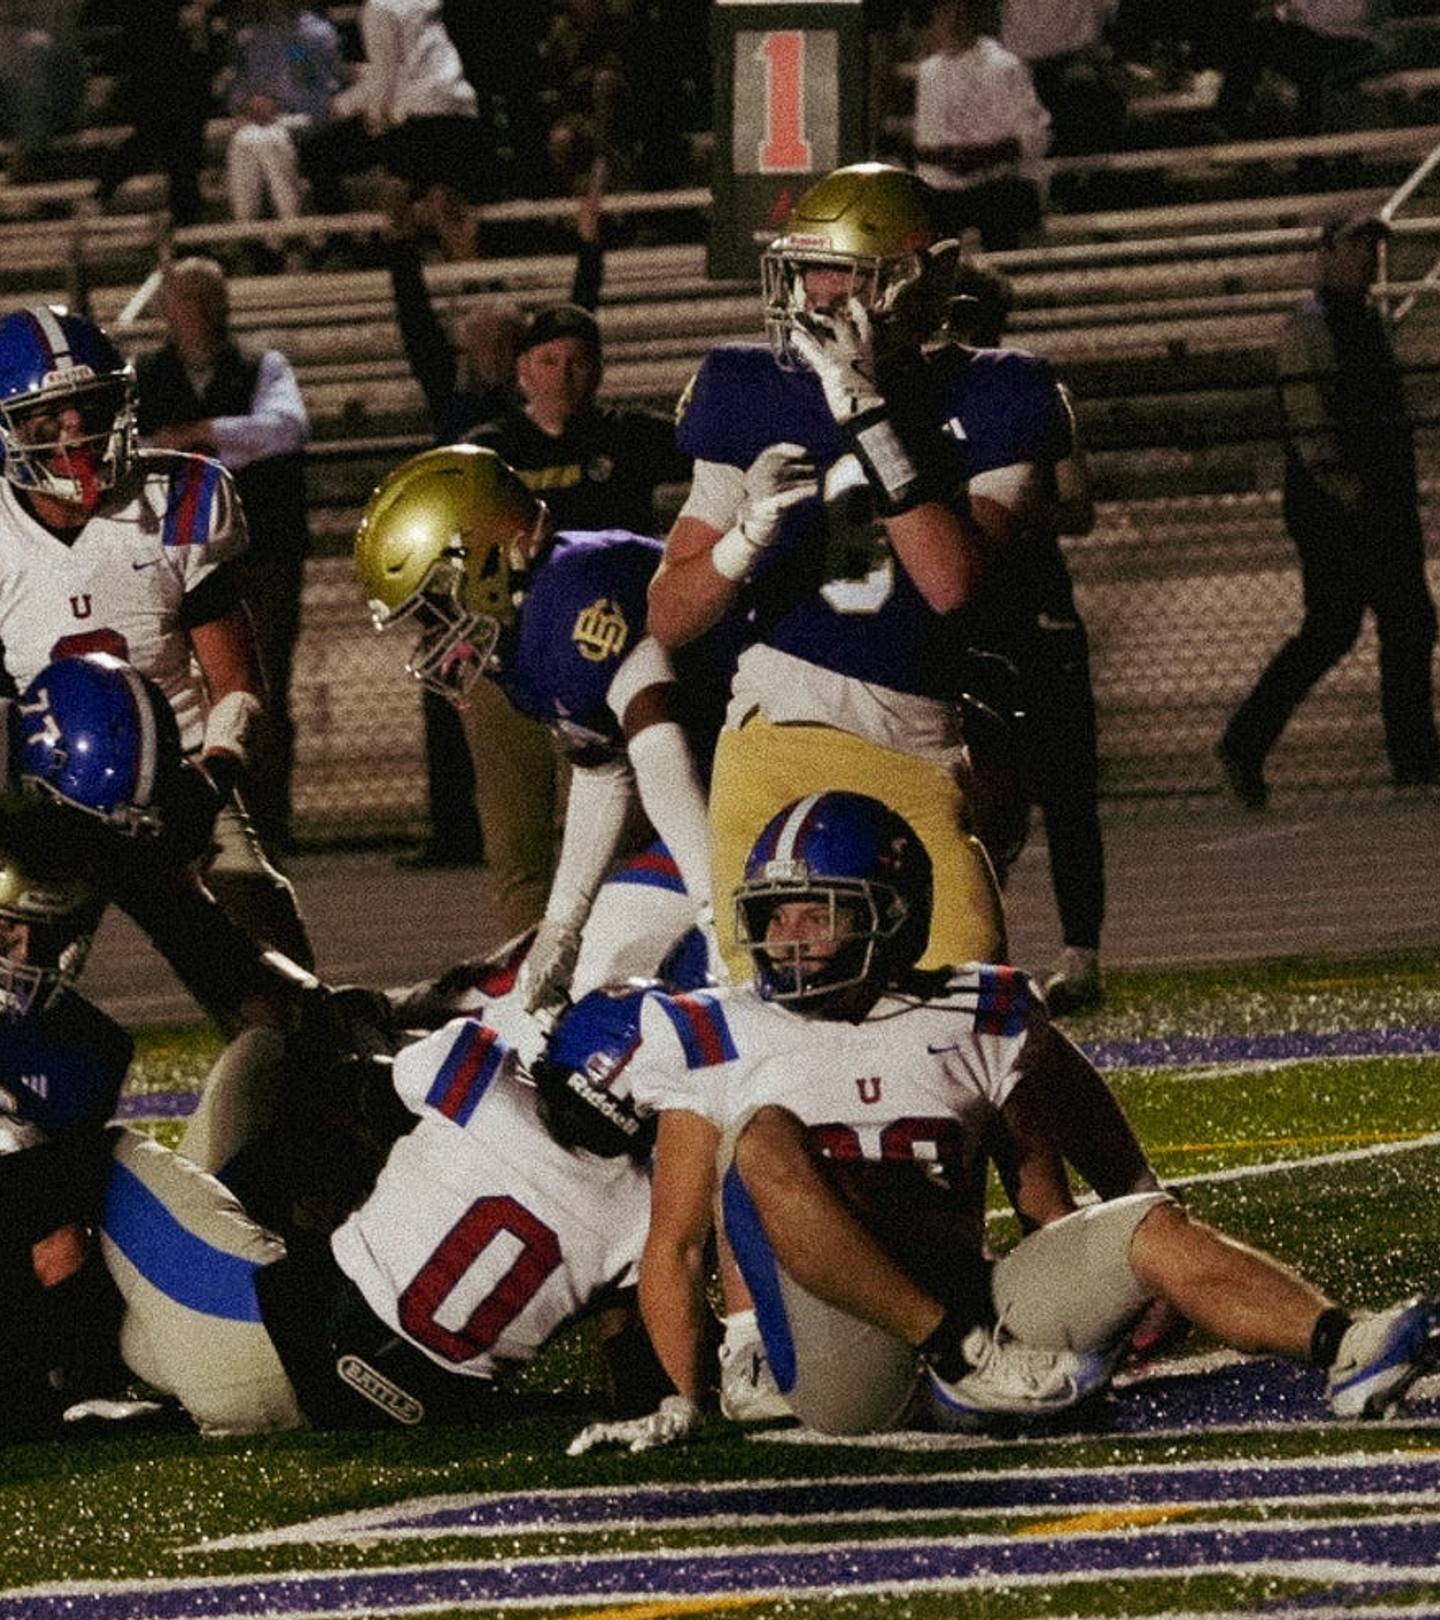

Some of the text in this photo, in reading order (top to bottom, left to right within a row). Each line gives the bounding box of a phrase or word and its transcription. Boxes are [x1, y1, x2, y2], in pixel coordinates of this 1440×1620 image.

[759, 30, 811, 174] 1
[70, 594, 92, 619] U
[18, 687, 61, 748] 77
[566, 1071, 640, 1137] Riddell
[856, 1077, 882, 1104] U
[397, 1195, 563, 1364] 0
[342, 1359, 420, 1420] BATTLE
